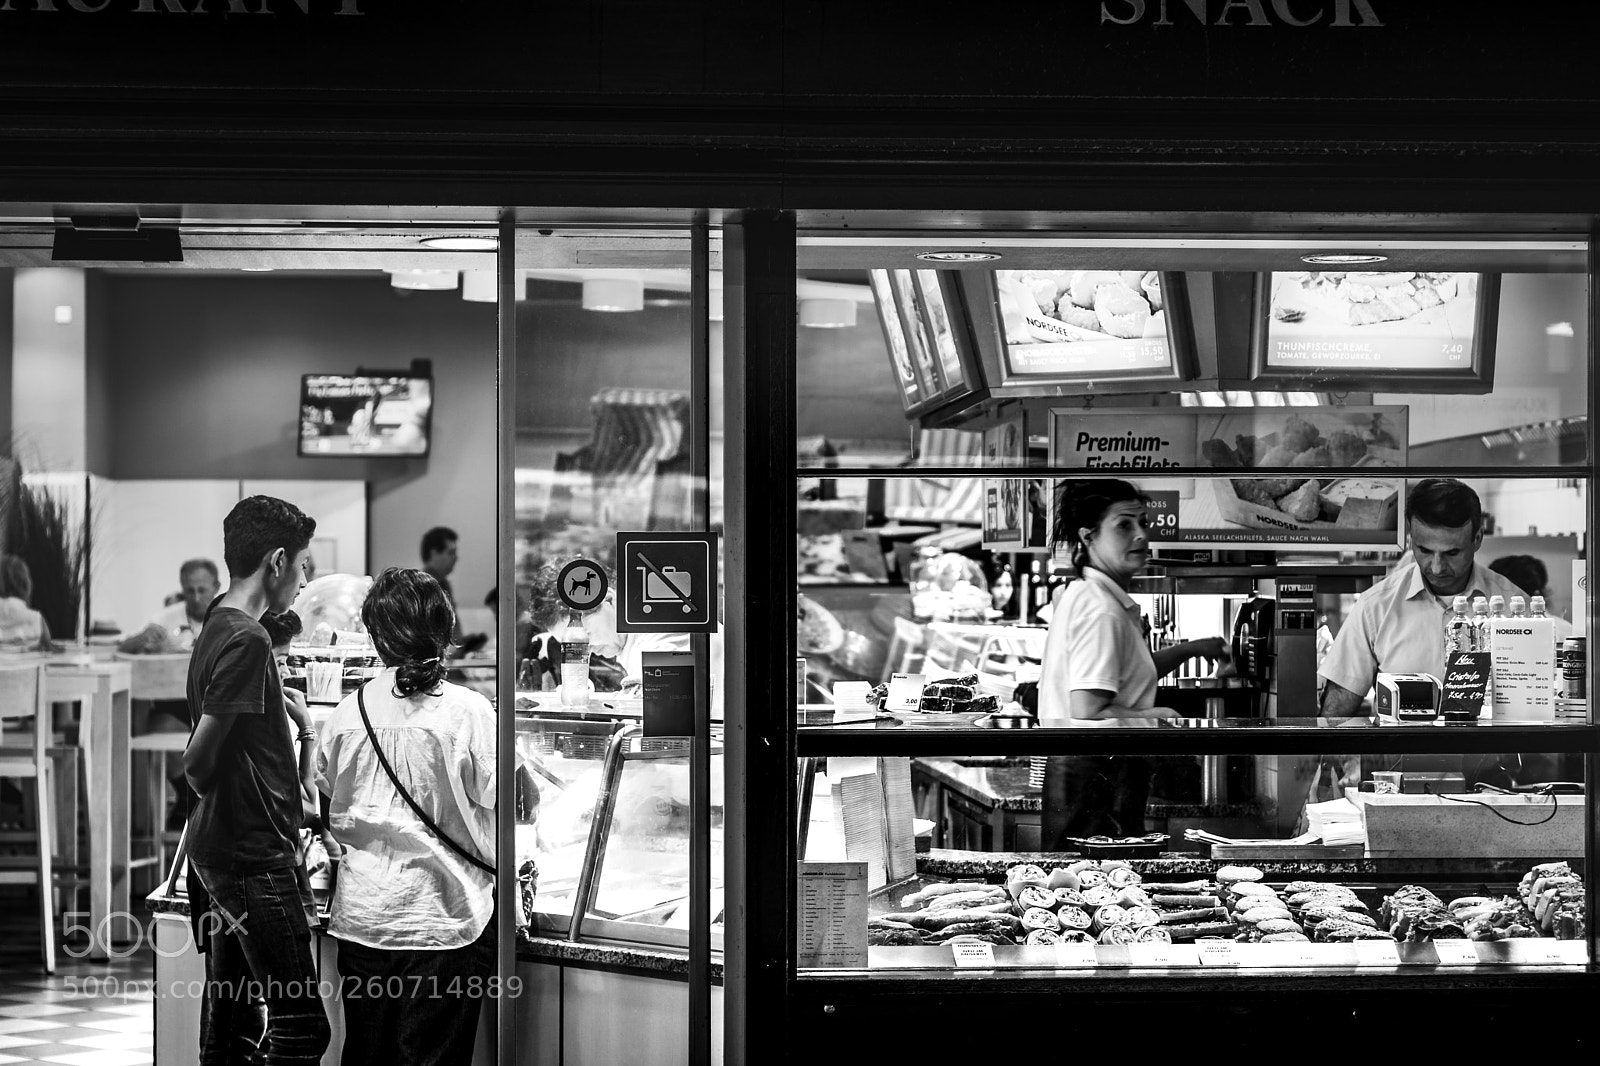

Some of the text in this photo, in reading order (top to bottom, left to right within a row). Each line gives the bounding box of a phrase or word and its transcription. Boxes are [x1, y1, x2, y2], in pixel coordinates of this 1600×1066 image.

[1025, 316, 1068, 337] NORDSEE
[1076, 431, 1170, 452] Premium-
[1145, 514, 1177, 529] ,50
[1256, 514, 1299, 531] NORDSEE
[1160, 528, 1176, 536] CHF
[1212, 534, 1265, 542] SEELACHSFILETS,
